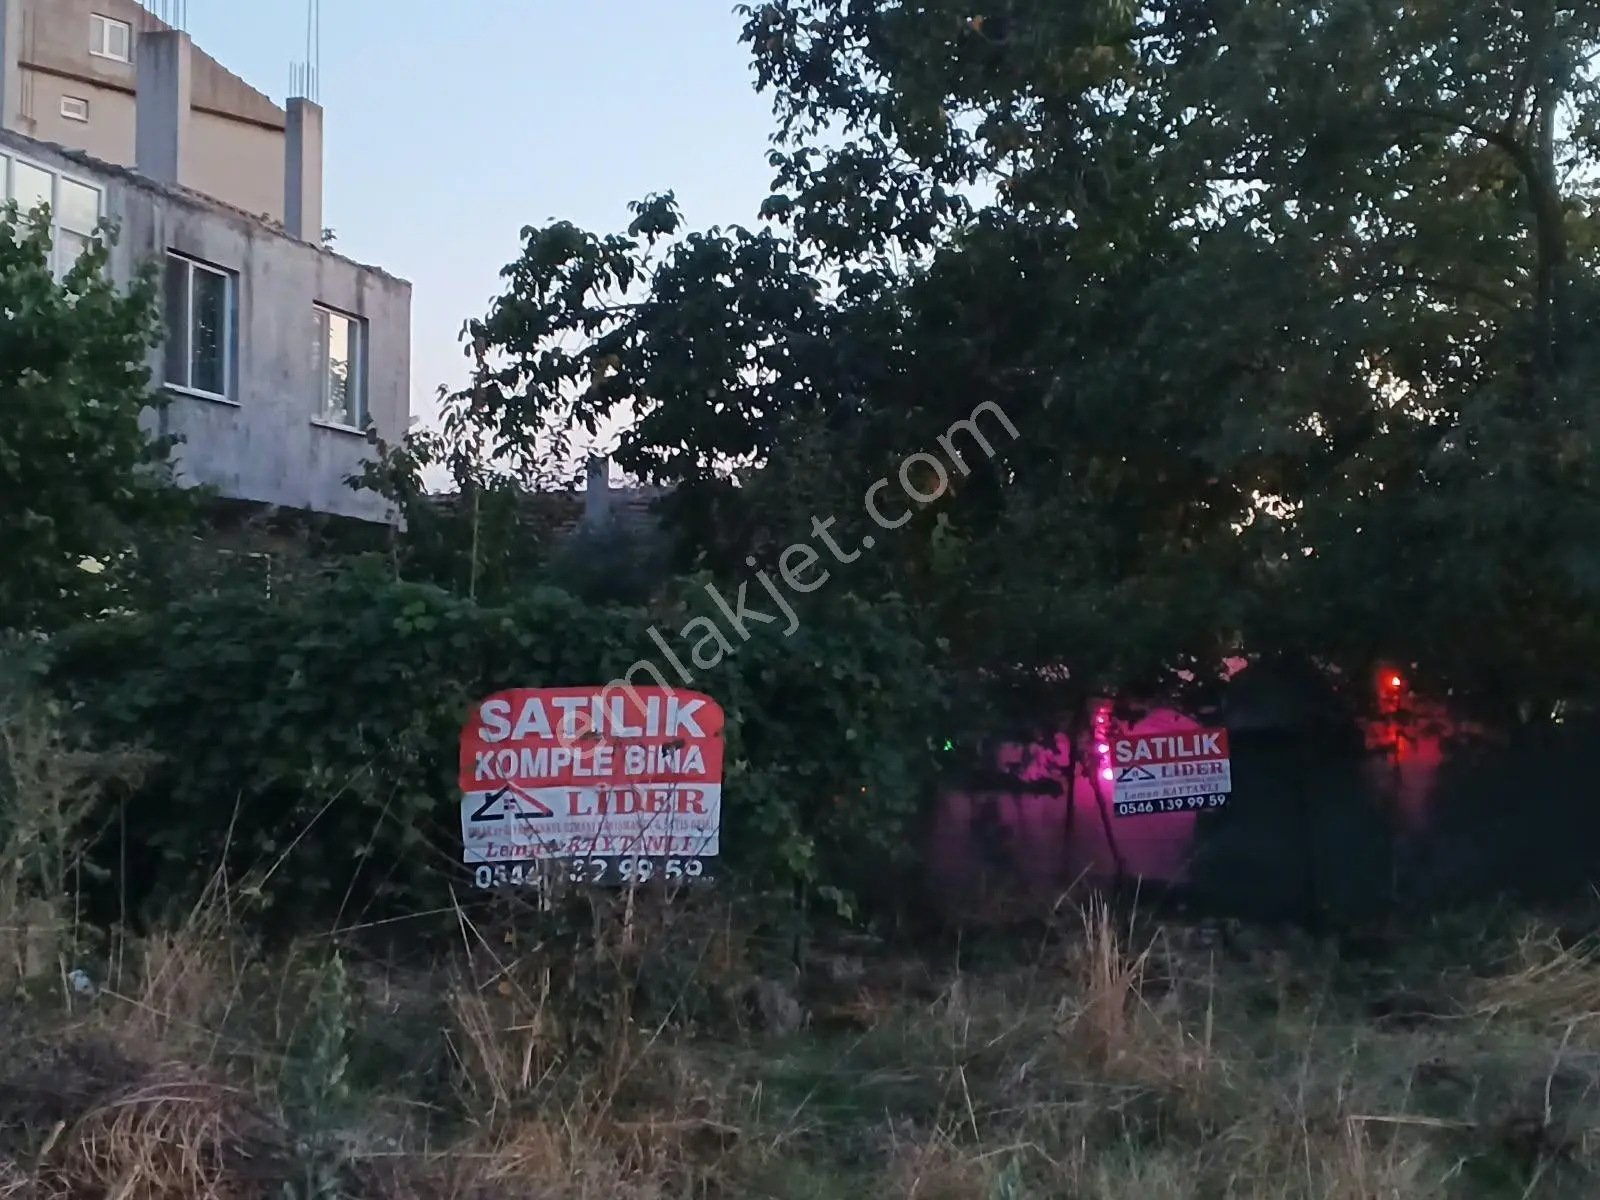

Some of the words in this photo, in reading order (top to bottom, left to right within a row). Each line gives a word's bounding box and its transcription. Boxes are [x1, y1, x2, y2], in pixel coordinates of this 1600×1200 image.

[478, 695, 707, 743] SATILIK
[475, 746, 613, 781] KOMPLE
[1116, 732, 1221, 763] SATILIK
[567, 783, 708, 816] LİDER
[1120, 802, 1154, 815] 0546
[1159, 798, 1183, 811] 139
[1187, 796, 1204, 808] 99
[1209, 794, 1226, 806] 59
[618, 857, 653, 884] 99
